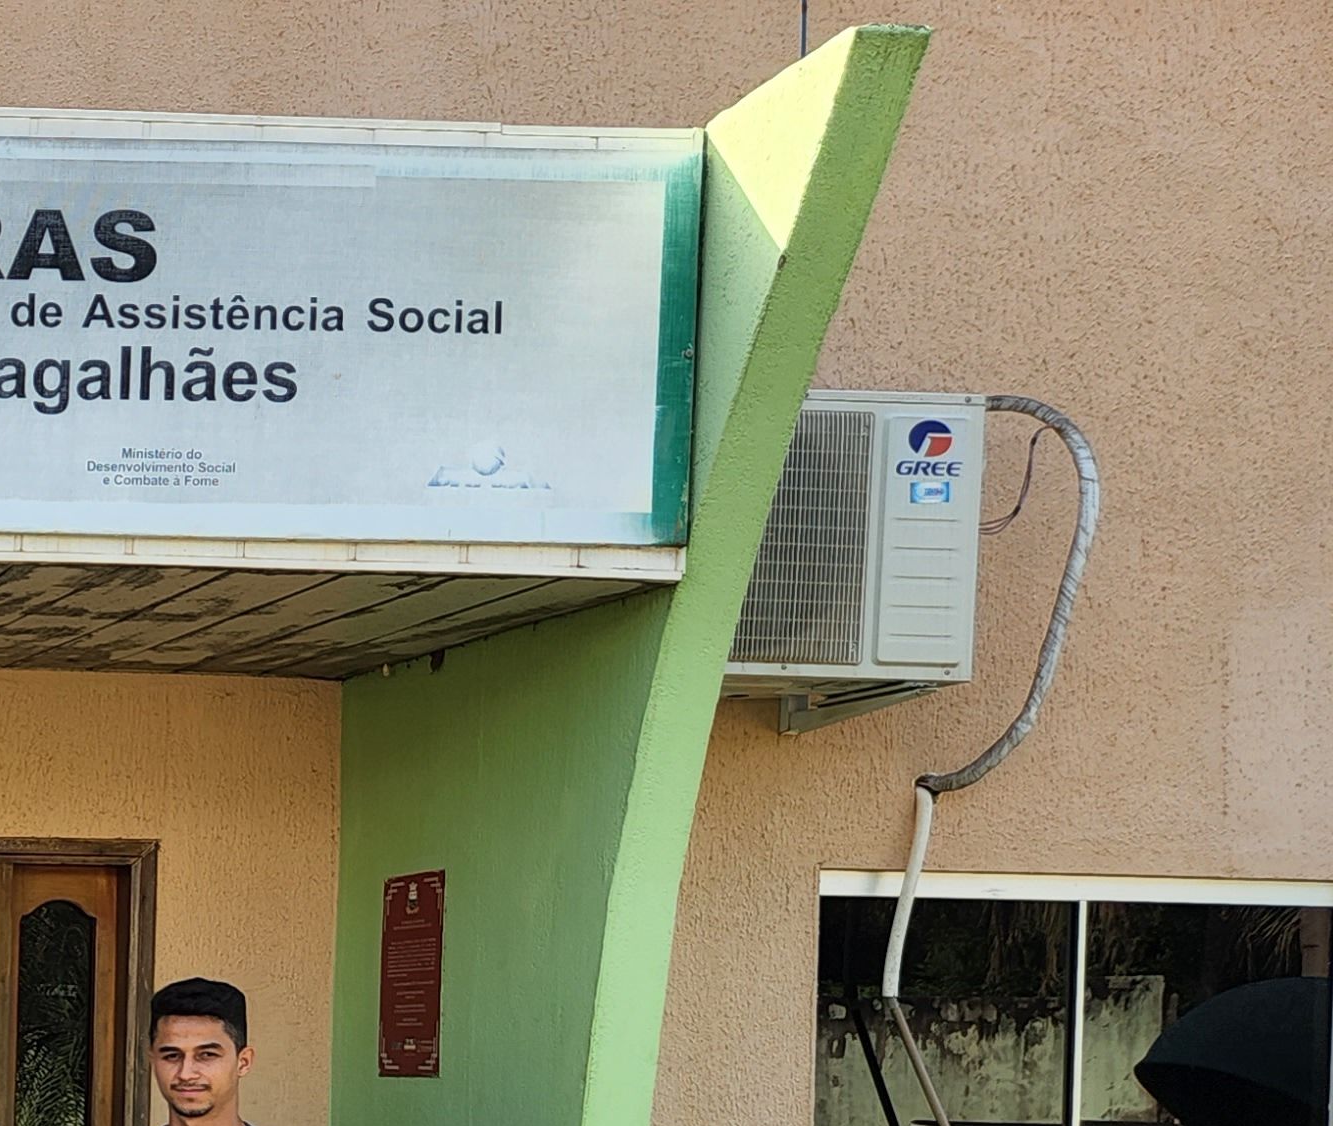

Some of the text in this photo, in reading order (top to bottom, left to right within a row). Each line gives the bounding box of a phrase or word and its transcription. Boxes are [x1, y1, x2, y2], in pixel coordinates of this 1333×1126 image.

[10, 293, 63, 328] de
[81, 294, 344, 332] Assistência
[367, 298, 503, 335] Social
[121, 448, 202, 460] Ministério do
[87, 460, 236, 473] Desenvolvimento Social
[896, 460, 963, 477] GREE
[102, 474, 220, 487] e Combate à Fome
